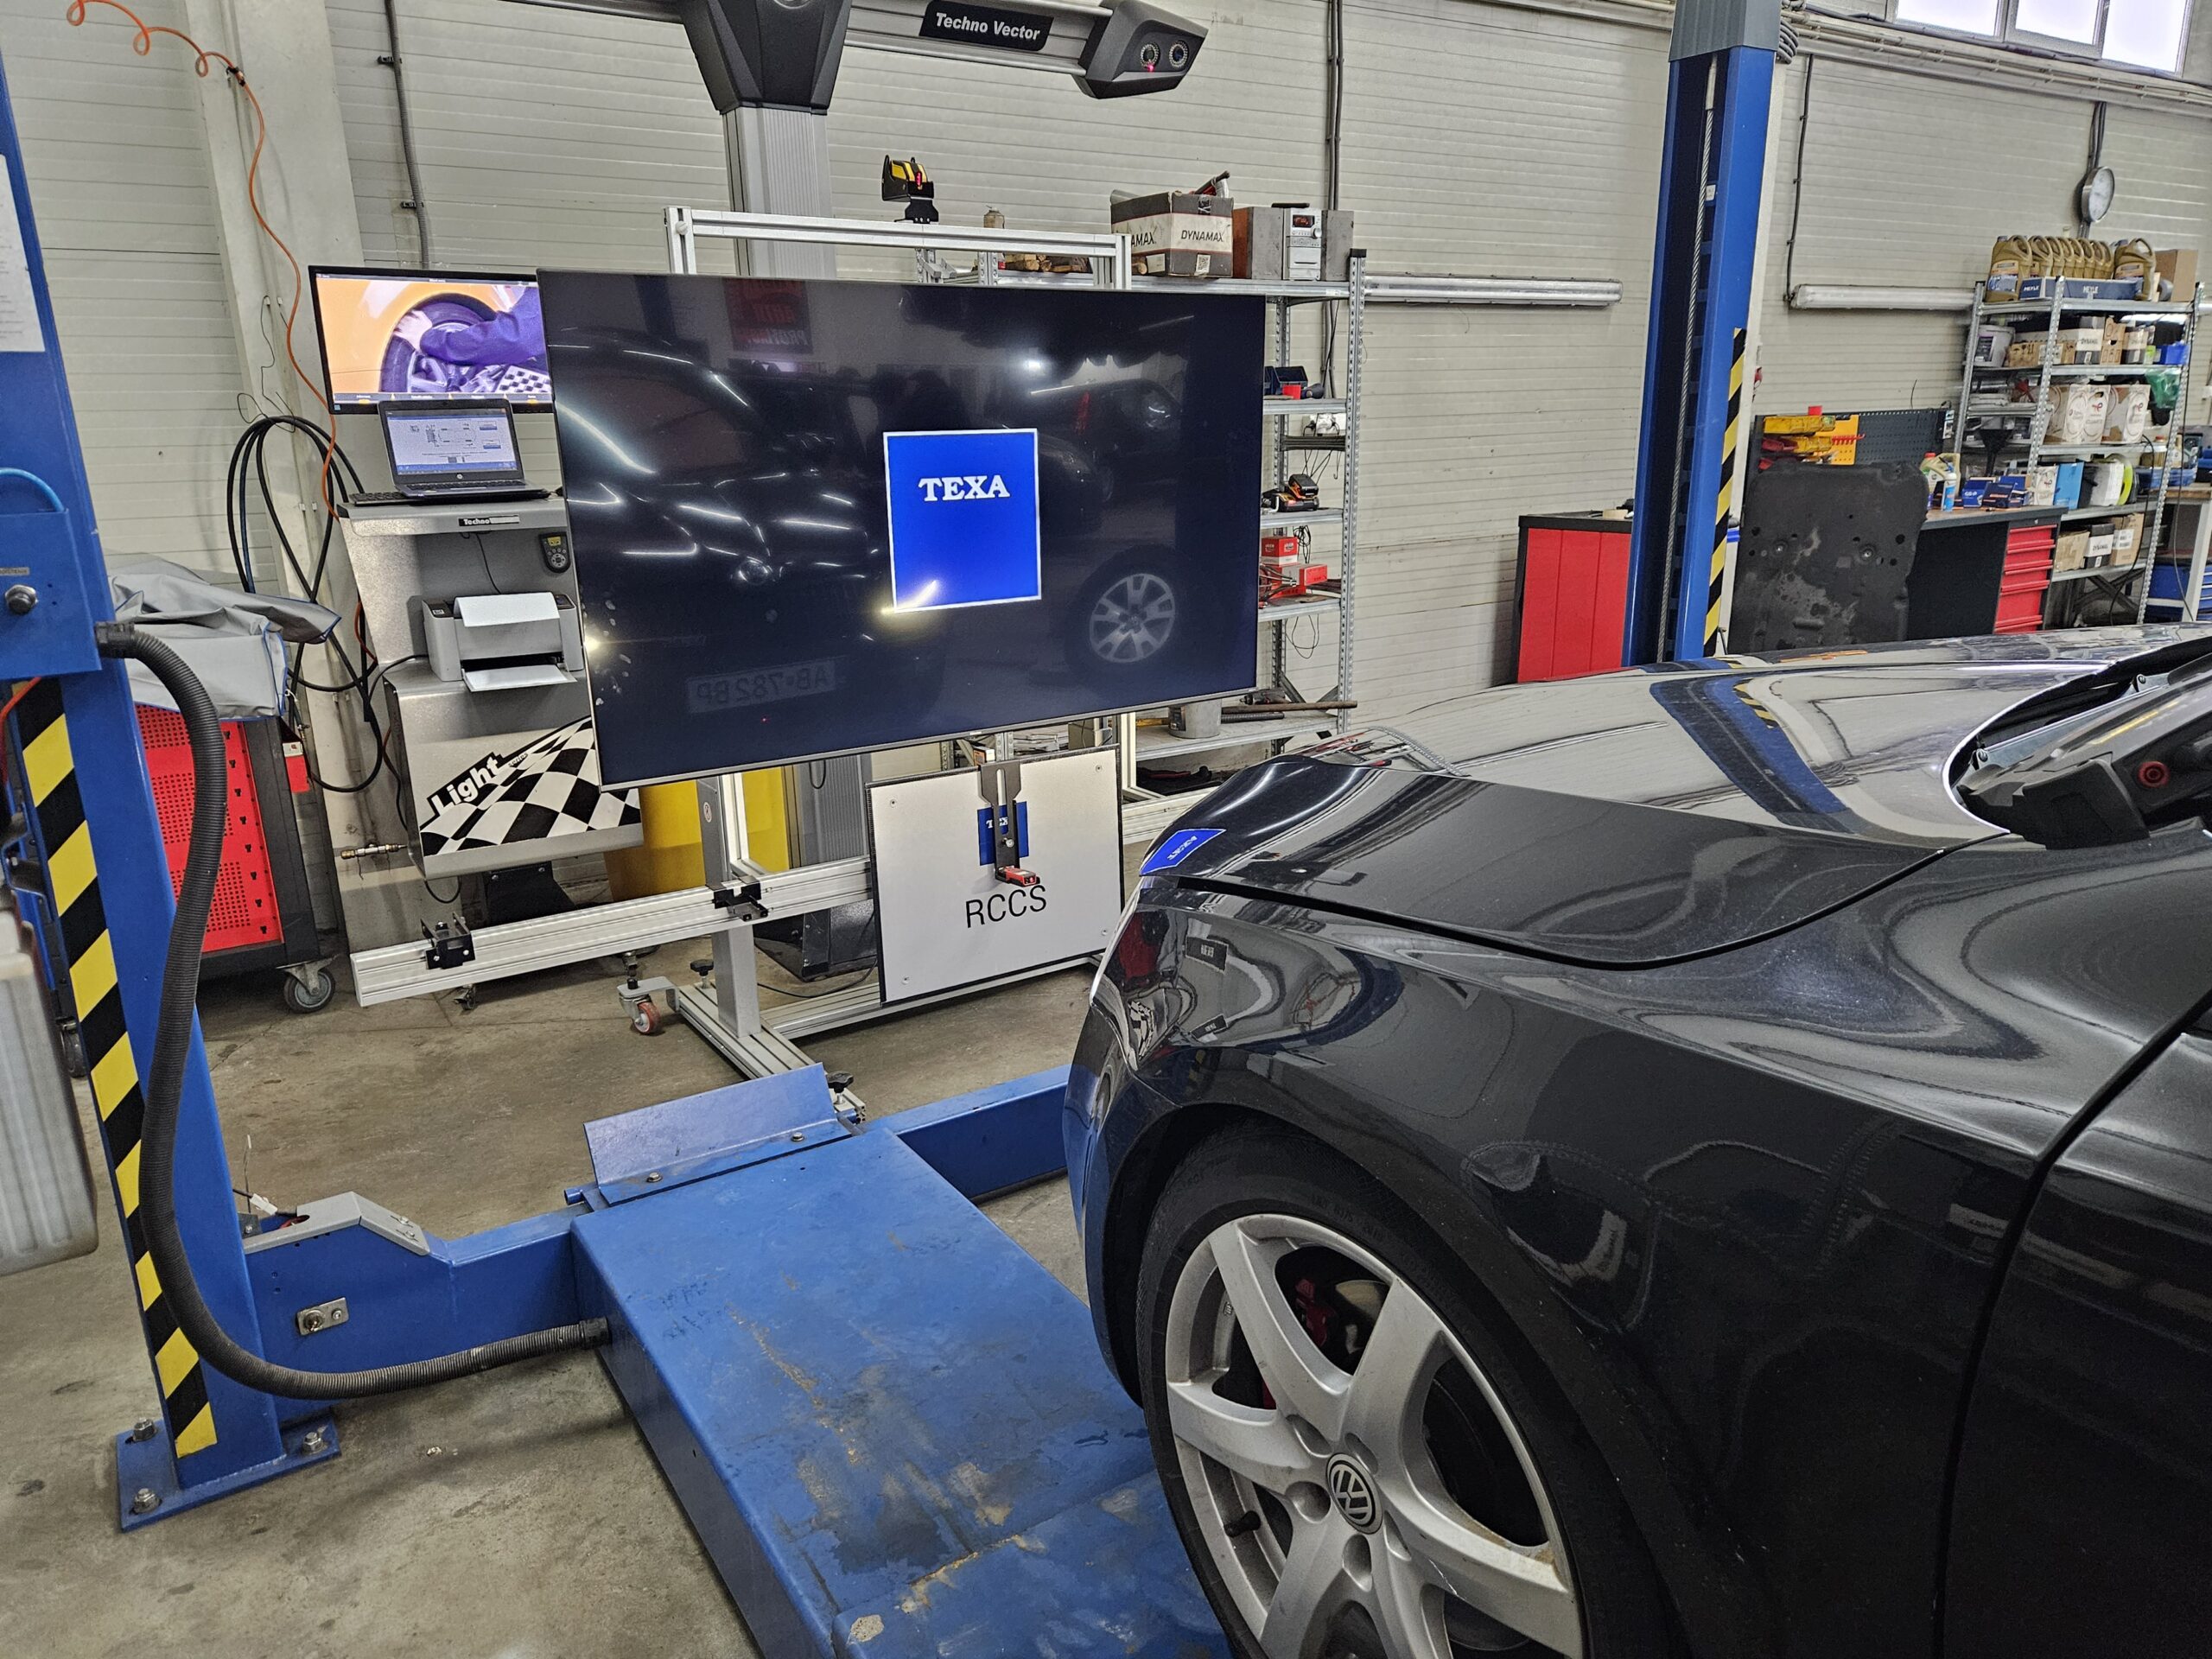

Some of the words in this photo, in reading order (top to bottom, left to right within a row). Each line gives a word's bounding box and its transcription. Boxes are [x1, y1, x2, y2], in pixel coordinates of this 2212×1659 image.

[936, 12, 988, 33] Techno
[994, 20, 1040, 40] Vector
[1180, 229, 1224, 242] DYNAMAX
[918, 474, 1010, 501] TEXA
[507, 753, 529, 768] series
[431, 756, 499, 816] Light
[965, 884, 1047, 929] RCCS
